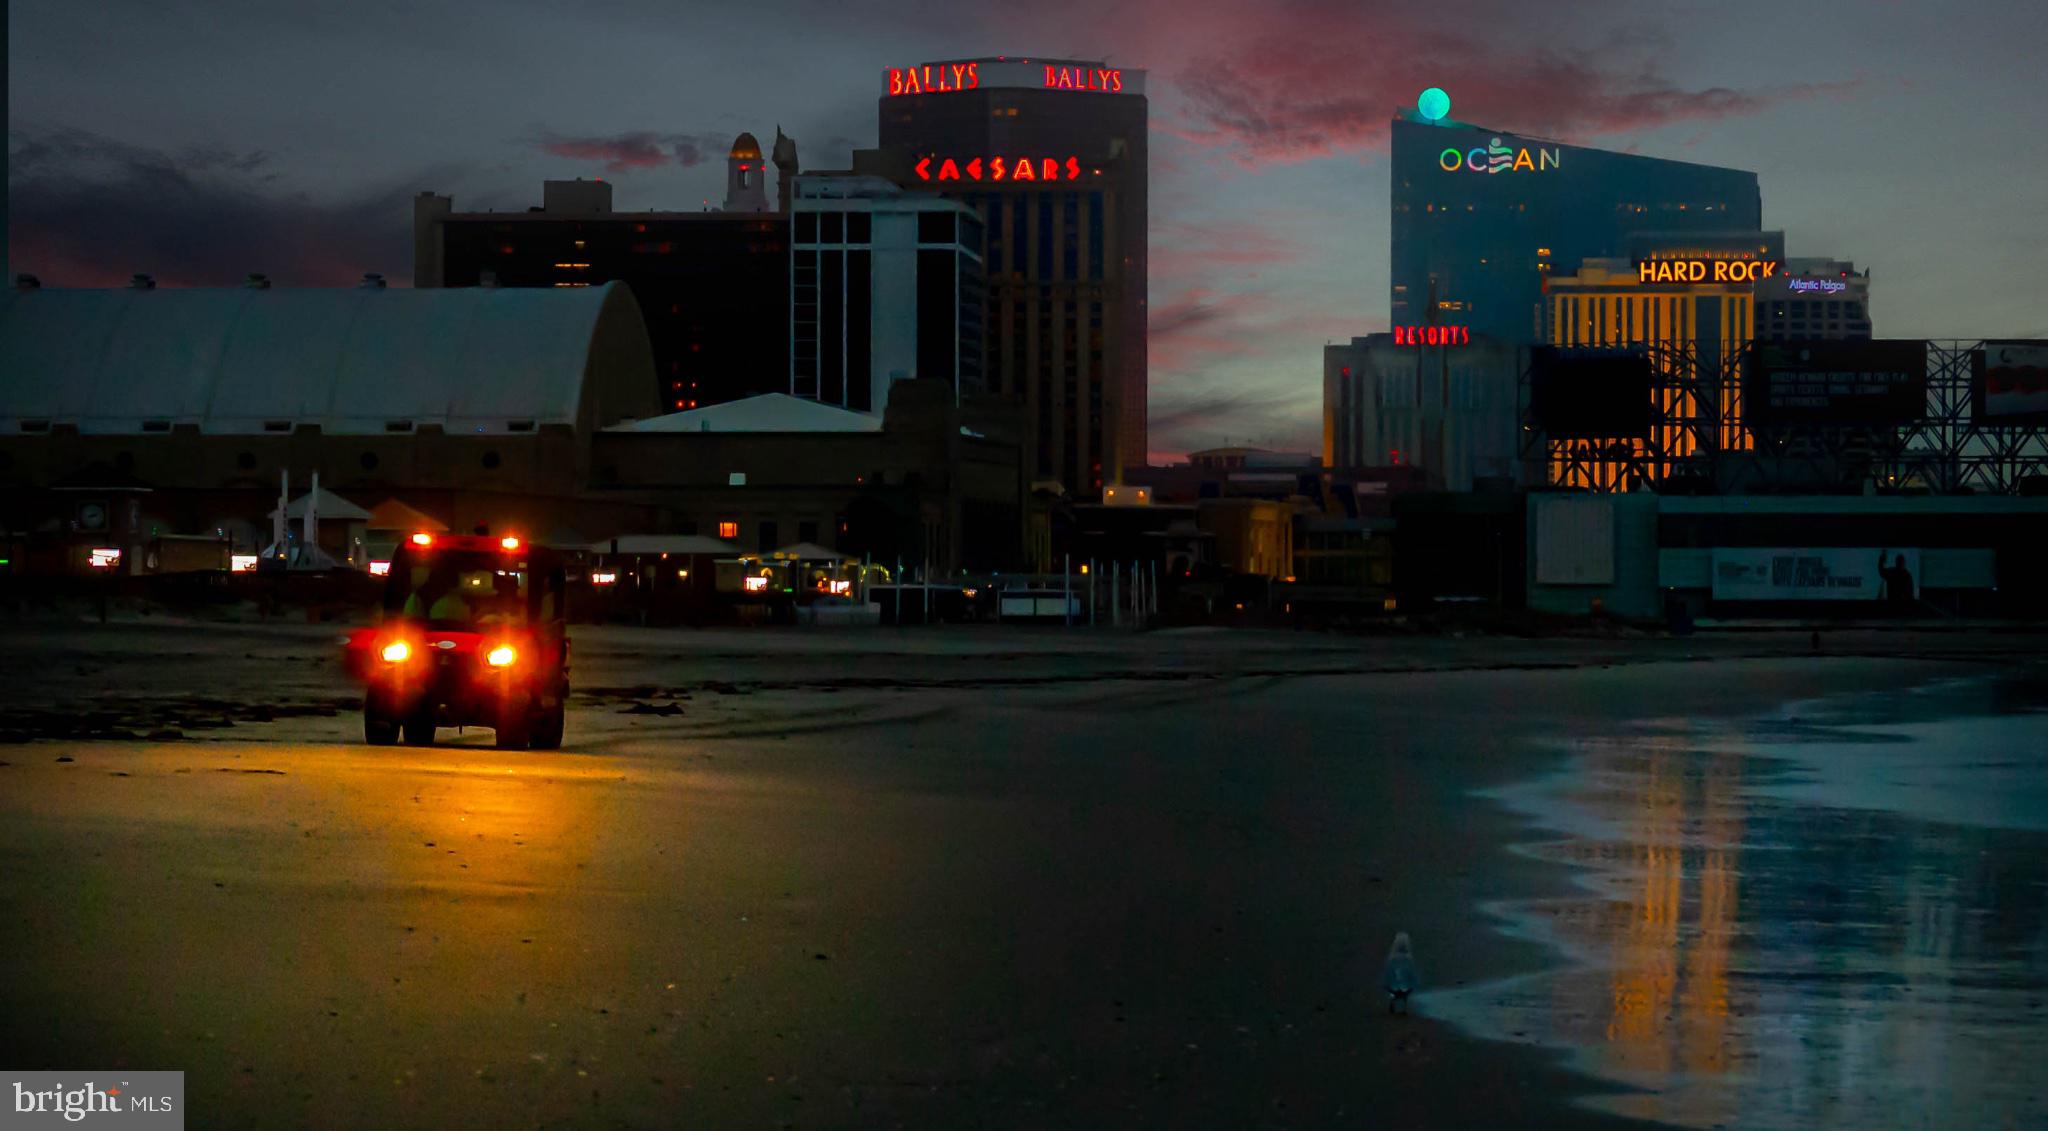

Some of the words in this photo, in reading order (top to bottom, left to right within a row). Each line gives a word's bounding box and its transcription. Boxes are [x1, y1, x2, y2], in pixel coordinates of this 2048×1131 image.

[889, 63, 979, 96] BALLYS
[1045, 65, 1122, 91] BALLYS
[914, 155, 1081, 182] CAESARS
[1439, 138, 1560, 174] OCEAN
[1640, 261, 1706, 282] HARD
[1714, 261, 1776, 282] ROCK
[1789, 279, 1819, 290] Atlantic
[1394, 325, 1469, 346] RESORTS
